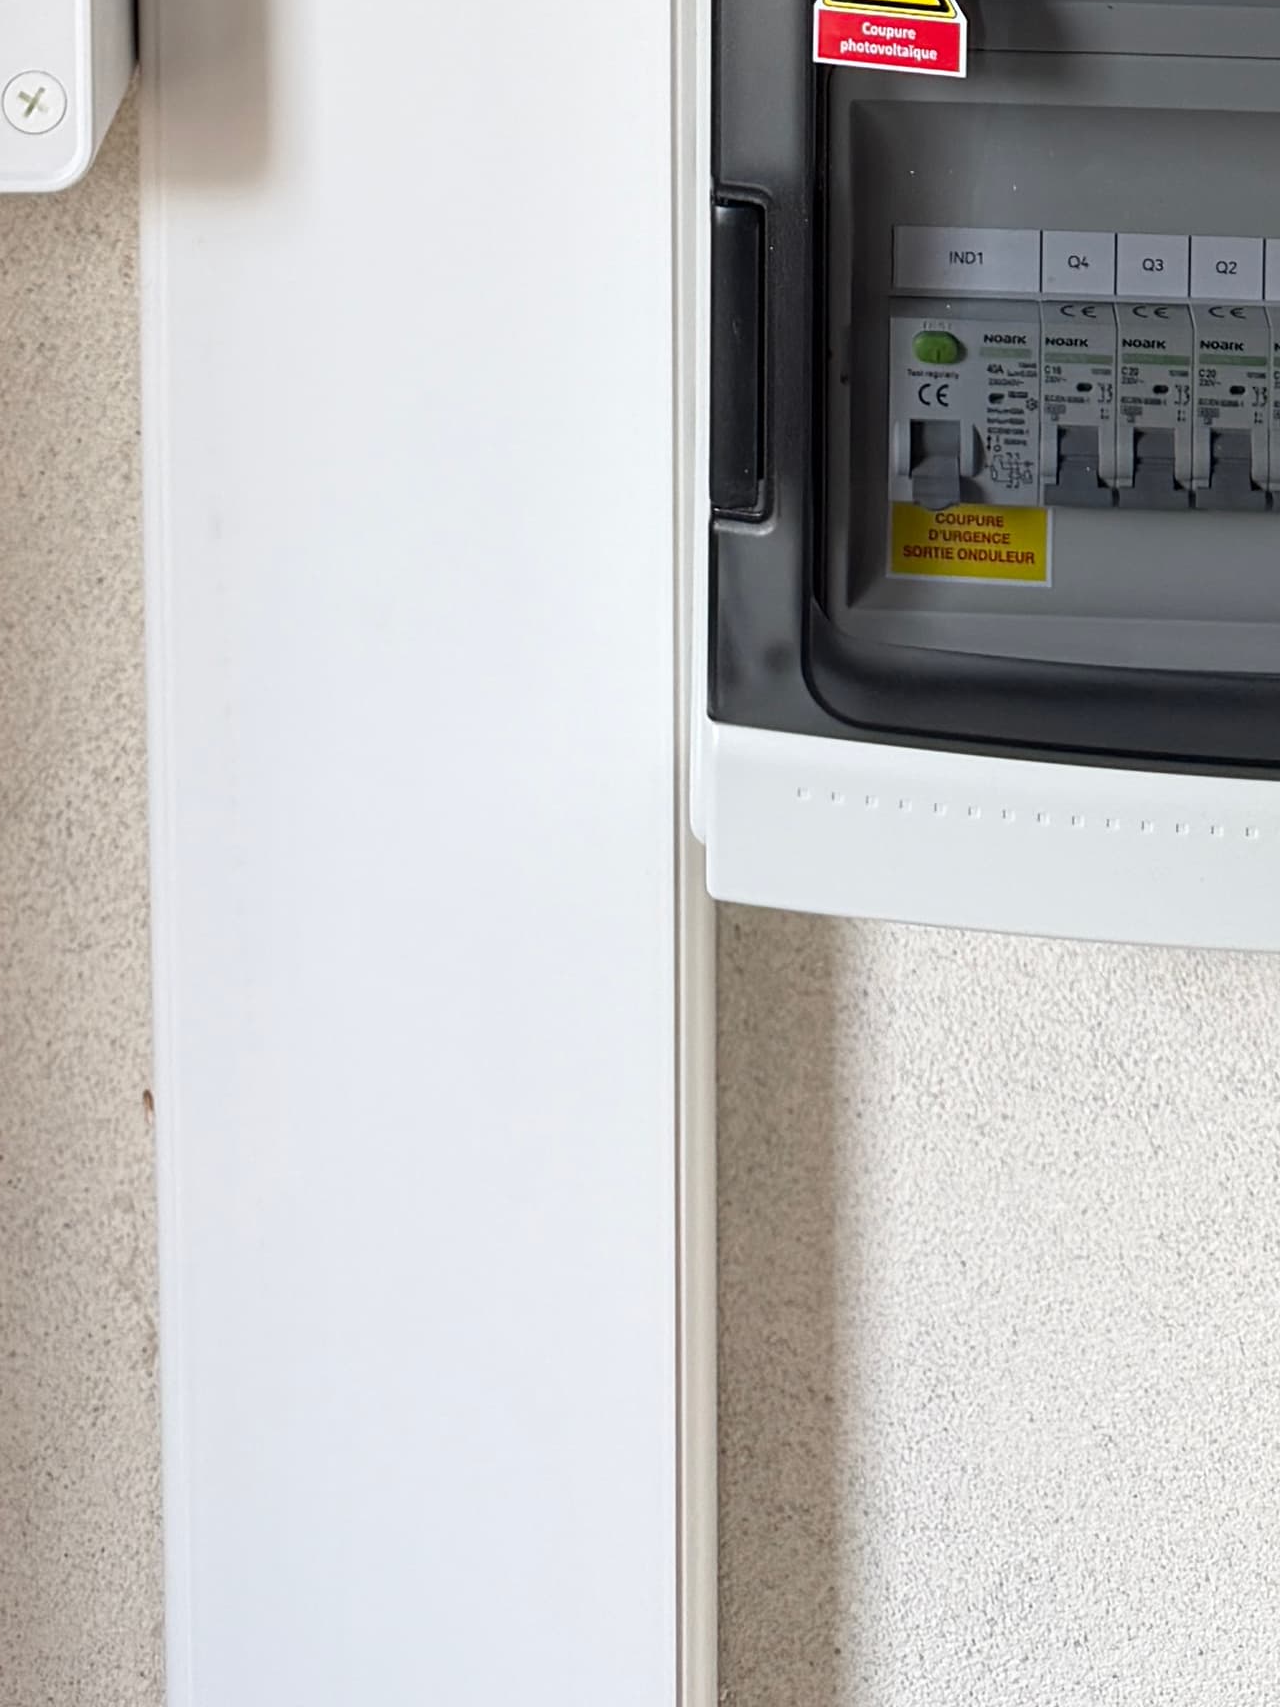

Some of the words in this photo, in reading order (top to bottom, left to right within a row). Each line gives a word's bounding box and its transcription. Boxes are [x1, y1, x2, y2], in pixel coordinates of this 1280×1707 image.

[861, 21, 917, 41] Coupure
[839, 38, 938, 61] photovoltaïque
[949, 250, 984, 265] IND1
[1067, 254, 1090, 269] Q4
[1142, 258, 1164, 272] Q3
[1215, 261, 1238, 275] Q2
[935, 513, 1004, 528] COUPURE
[928, 529, 1010, 545] D'URGENCE
[903, 546, 954, 561] SORTIE
[956, 548, 1035, 565] ONDULEUR
